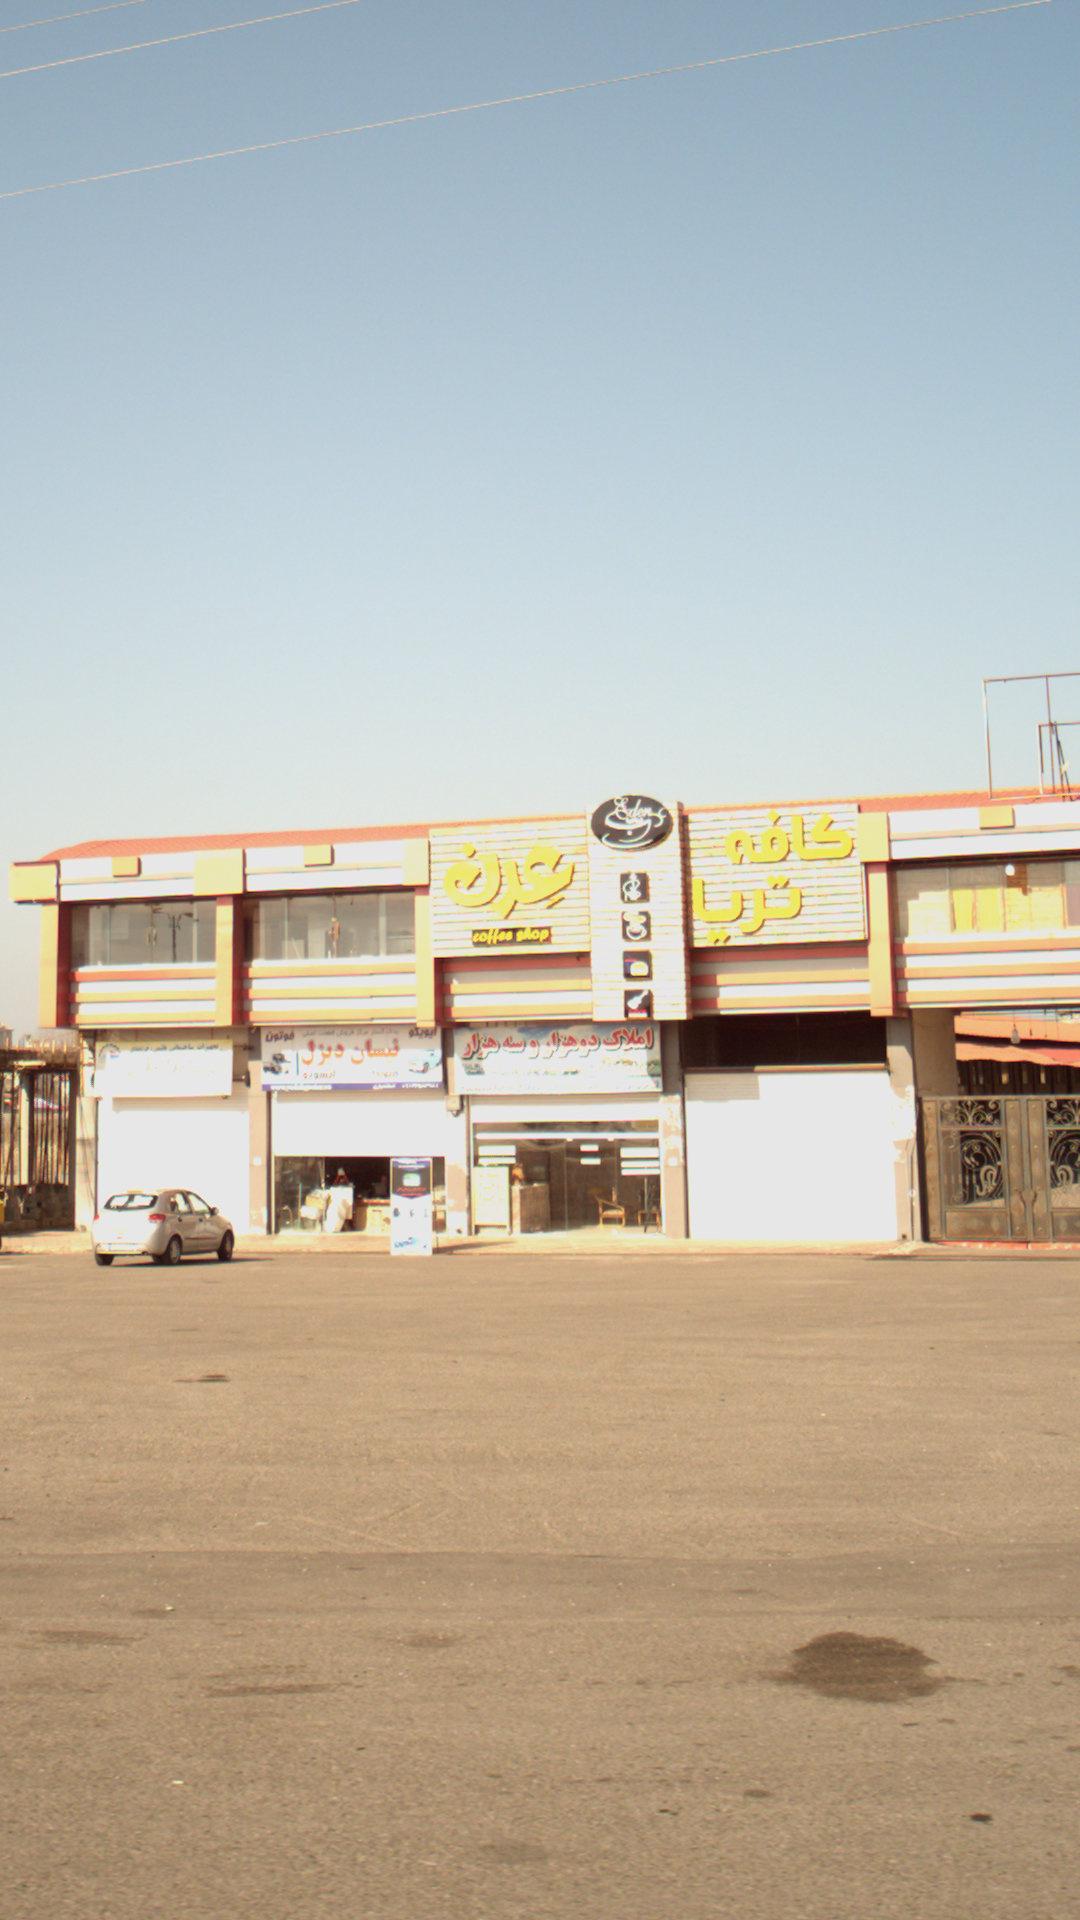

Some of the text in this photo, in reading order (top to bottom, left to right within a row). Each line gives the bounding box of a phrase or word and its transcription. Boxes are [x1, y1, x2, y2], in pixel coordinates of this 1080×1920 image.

[724, 809, 854, 864] کافه
[443, 842, 575, 920] عدن
[691, 875, 803, 944] تریا
[472, 926, 549, 945] coffee shop
[302, 1037, 399, 1066] نیسان دیزل
[462, 1032, 501, 1060] هزار
[502, 1035, 526, 1053] سه
[528, 1039, 540, 1058] و
[602, 1026, 654, 1051] املاک
